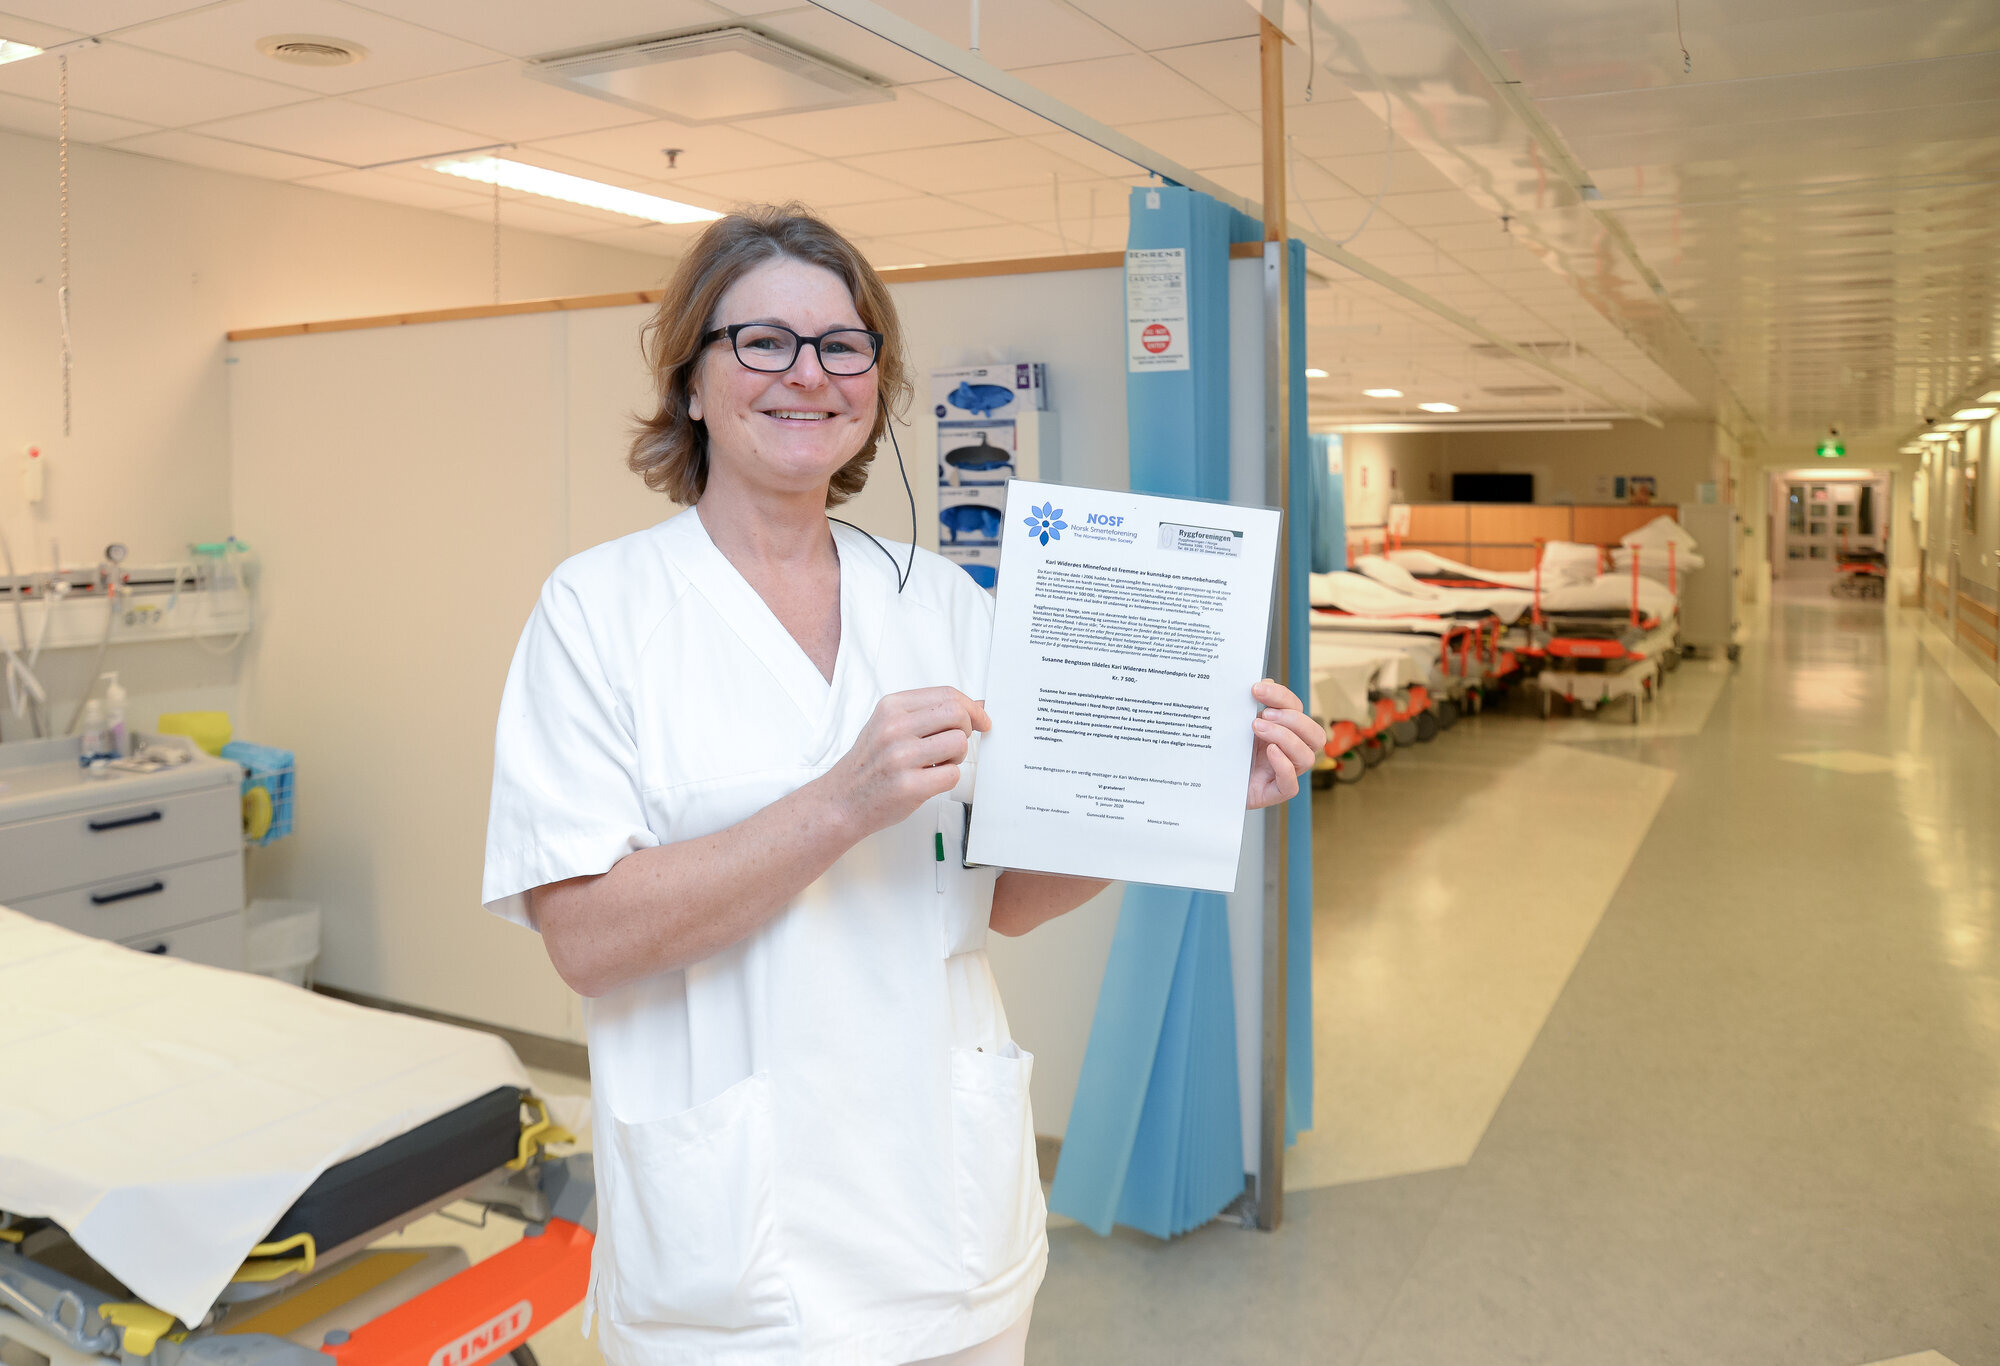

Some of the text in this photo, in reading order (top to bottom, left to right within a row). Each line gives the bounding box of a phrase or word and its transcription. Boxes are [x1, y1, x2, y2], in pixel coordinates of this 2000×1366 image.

[1086, 512, 1124, 527] NOSF
[1090, 527, 1136, 538] Smerteforening
[1178, 529, 1231, 542] Ryggforeningen
[1082, 563, 1111, 571] Minnefond
[1146, 570, 1171, 579] kunnskap
[1181, 576, 1227, 586] smertebehandling
[1148, 668, 1187, 677] Minnefondspris
[1124, 696, 1163, 705] barneavdelingene
[1038, 697, 1086, 706] Universitetssykehuset
[1162, 711, 1201, 719] Smerteavdelingen
[1053, 727, 1086, 736] gjennomføring
[1149, 777, 1182, 785] Minnefondspris
[443, 1310, 522, 1366] LINET
